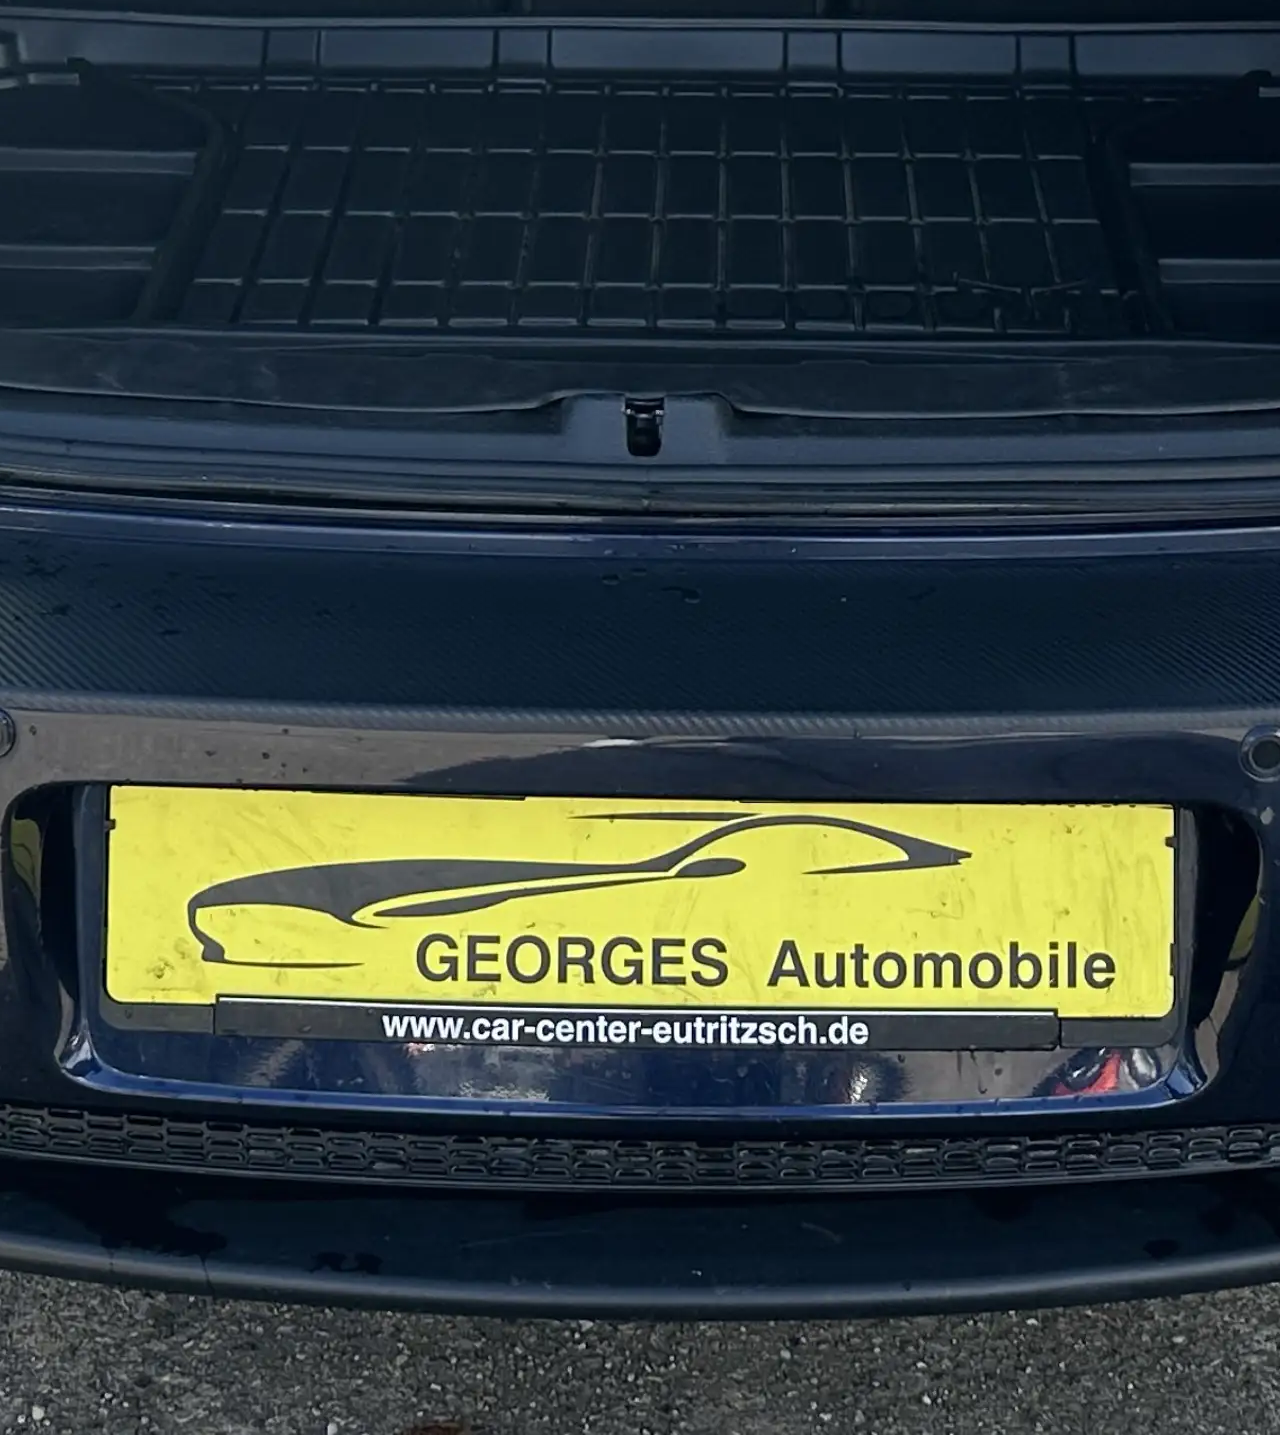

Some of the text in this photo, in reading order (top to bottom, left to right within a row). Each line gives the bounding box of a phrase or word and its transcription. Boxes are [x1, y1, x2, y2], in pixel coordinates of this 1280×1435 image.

[416, 933, 1116, 989] GEORGES Automobile
[382, 1014, 869, 1045] www.car-center-eutritzsch.de
